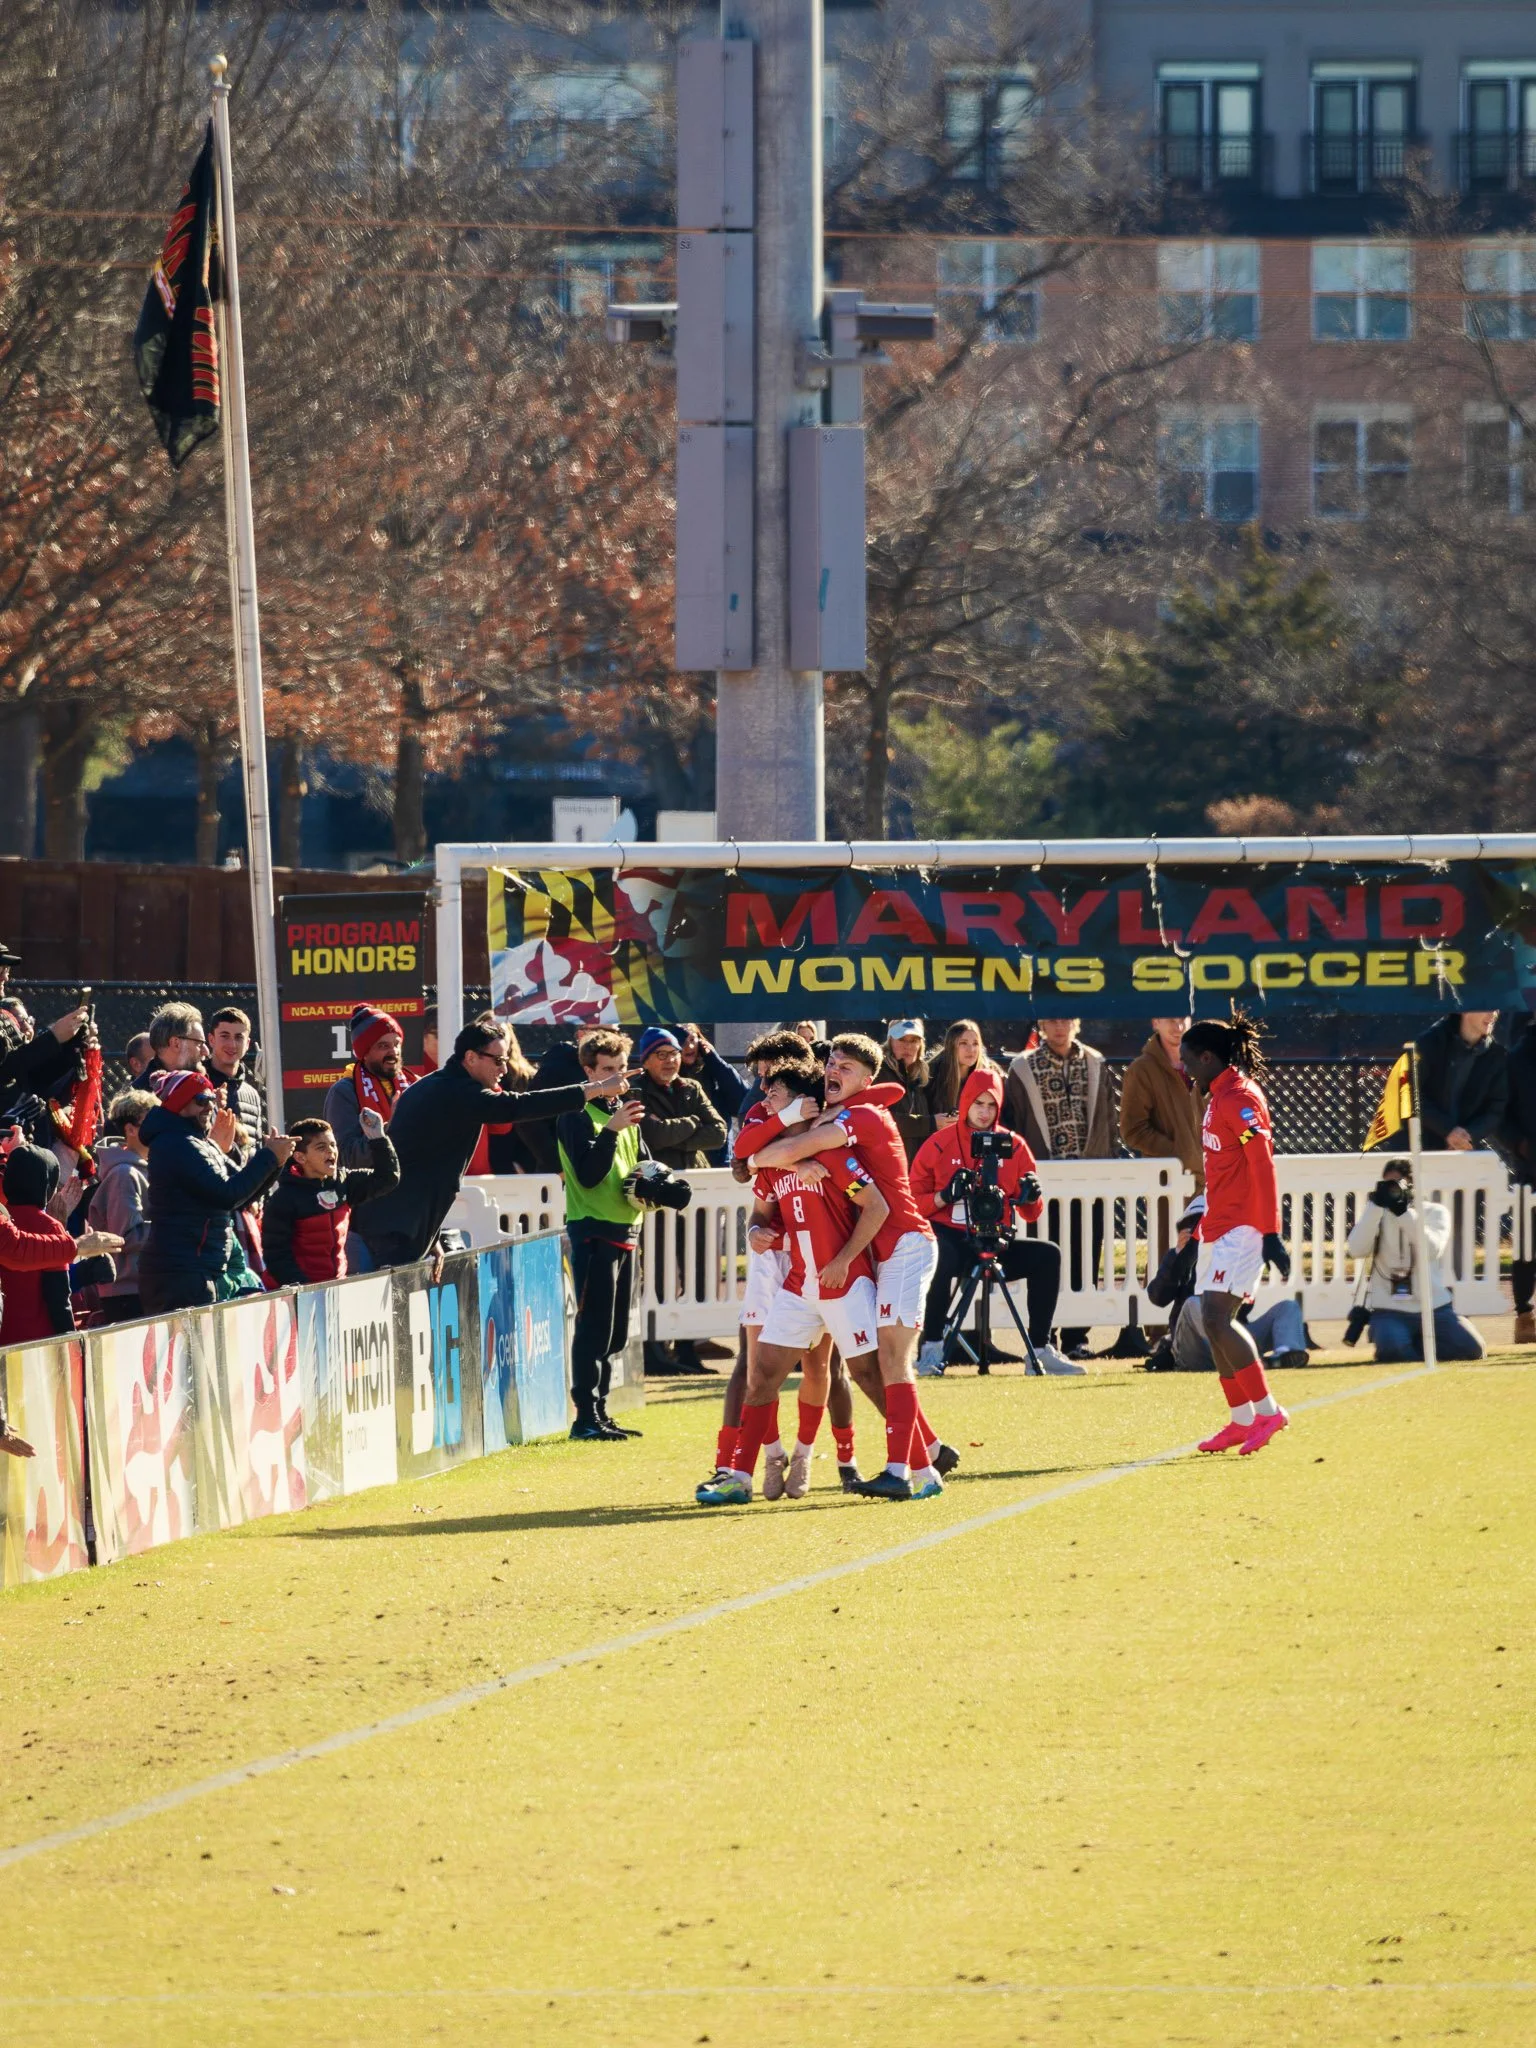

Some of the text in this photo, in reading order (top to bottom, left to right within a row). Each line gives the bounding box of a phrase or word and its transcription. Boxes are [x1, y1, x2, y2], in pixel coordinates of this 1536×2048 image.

[724, 883, 1465, 948] MARYLAND
[287, 920, 419, 948] PROGRAM
[292, 945, 416, 976] HONORS
[721, 951, 1466, 994] WOMEN'S SOCCER
[291, 1002, 417, 1017] NCAA TOUMENTS
[792, 1195, 805, 1223] 8
[1213, 1270, 1226, 1283] M
[880, 1303, 892, 1317] M
[853, 1330, 869, 1345] M
[343, 1320, 392, 1415] union
